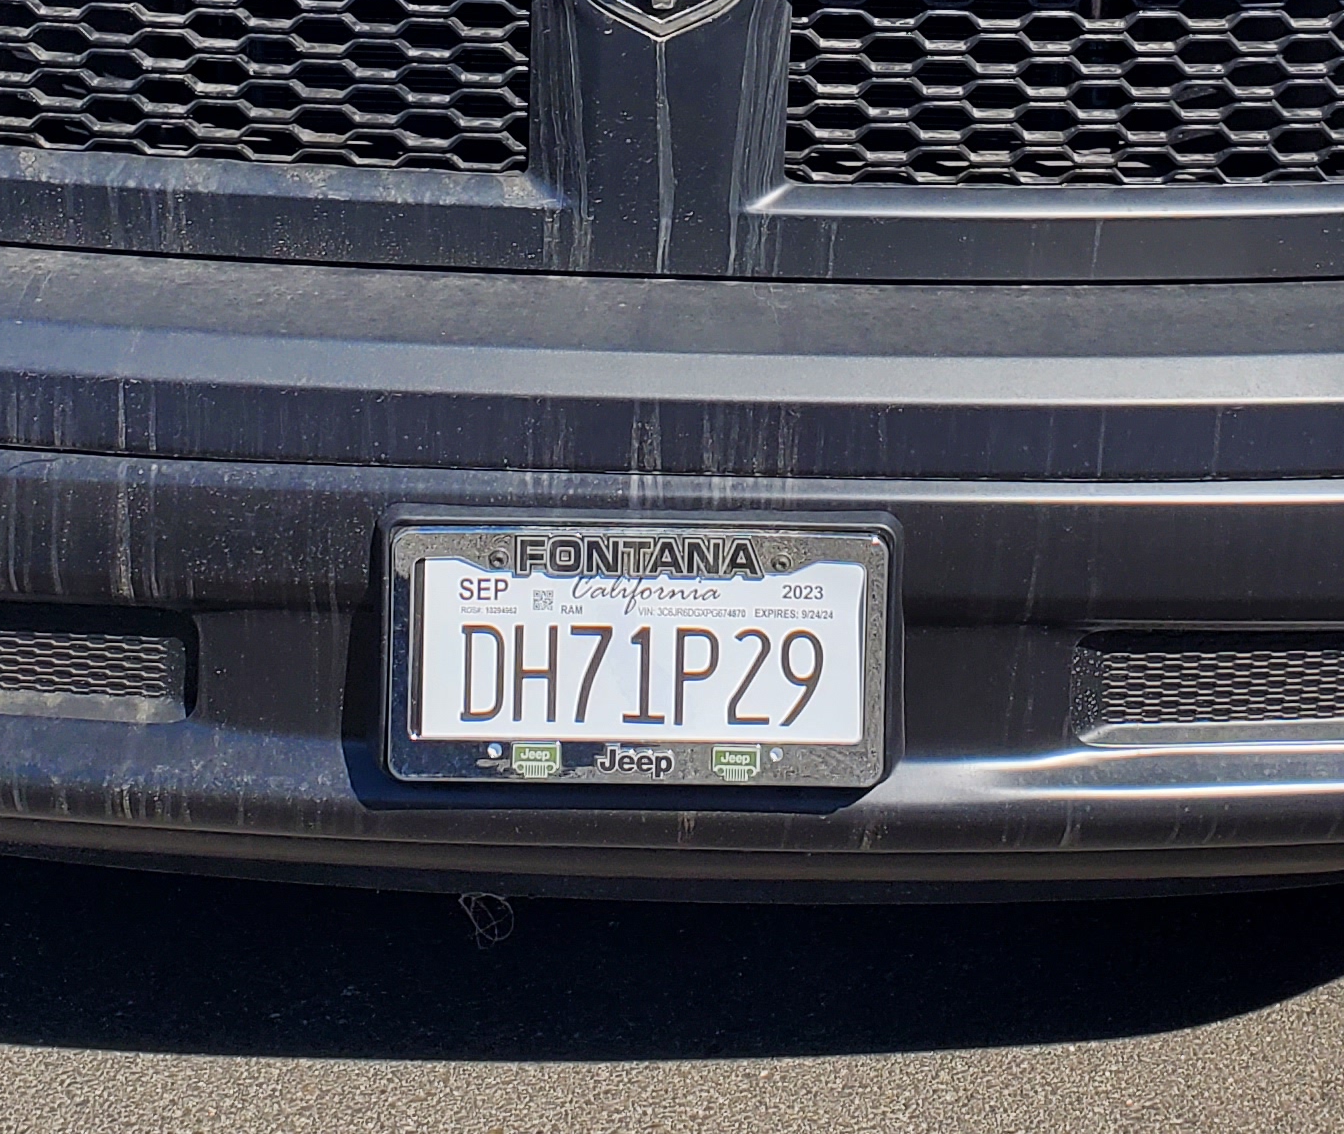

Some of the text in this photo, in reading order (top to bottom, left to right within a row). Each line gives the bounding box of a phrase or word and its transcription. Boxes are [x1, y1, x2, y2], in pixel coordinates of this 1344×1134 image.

[514, 534, 765, 578] FONTANA
[459, 577, 509, 601] SEP
[571, 575, 721, 615] California
[781, 584, 824, 600] 2023
[560, 605, 583, 615] RAM
[638, 606, 654, 616] VIN:
[754, 608, 833, 620] EXPIRES: 9/24/24
[460, 624, 824, 727] DH71P29
[519, 747, 551, 762] Jeep
[594, 743, 675, 780] Jeep
[720, 751, 751, 766] Jeep
